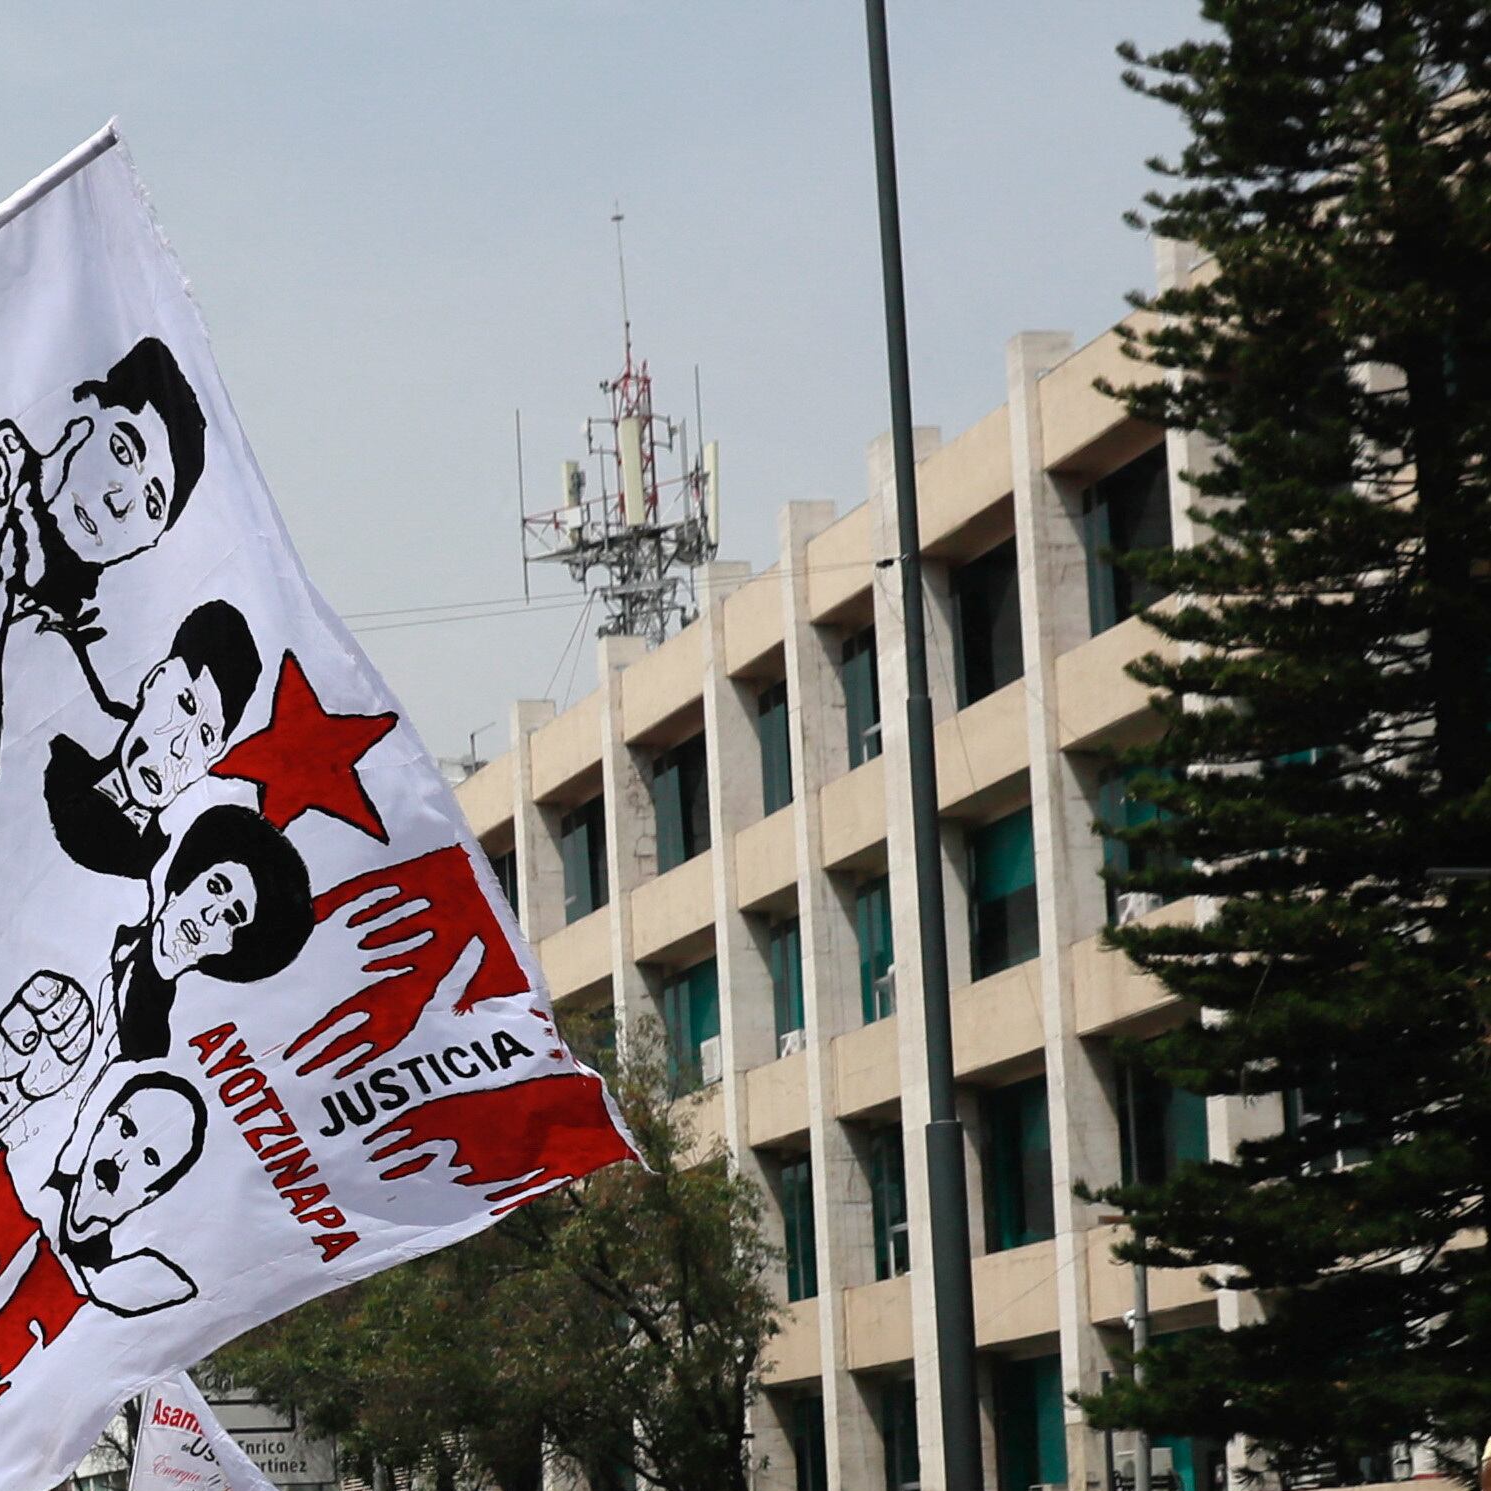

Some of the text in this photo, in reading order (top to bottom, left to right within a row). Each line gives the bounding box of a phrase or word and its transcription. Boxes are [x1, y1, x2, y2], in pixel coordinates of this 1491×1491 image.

[318, 1027, 535, 1138] JUSTICIA
[188, 1021, 361, 1263] AYOTZINAPA
[151, 1397, 206, 1438] Asam
[259, 1460, 307, 1474] rtínez
